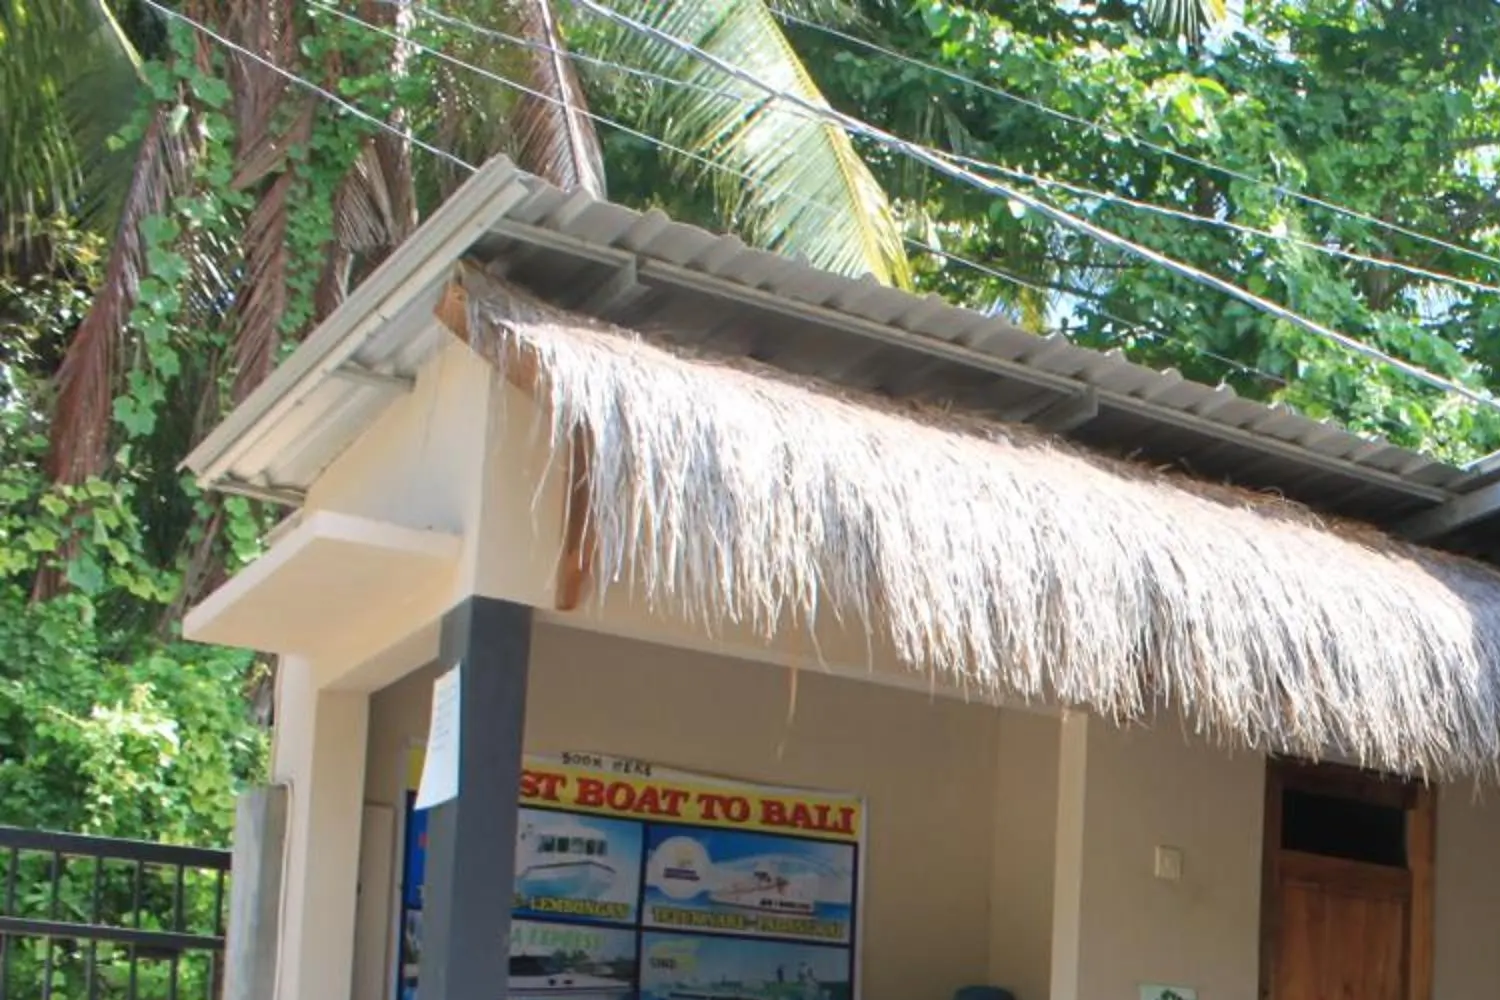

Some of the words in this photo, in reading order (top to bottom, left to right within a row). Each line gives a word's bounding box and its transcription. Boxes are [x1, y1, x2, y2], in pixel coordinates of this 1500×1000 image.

[520, 770, 567, 801] ST
[574, 777, 689, 817] BOAT
[697, 791, 750, 822] TO
[759, 799, 855, 834] BALI
